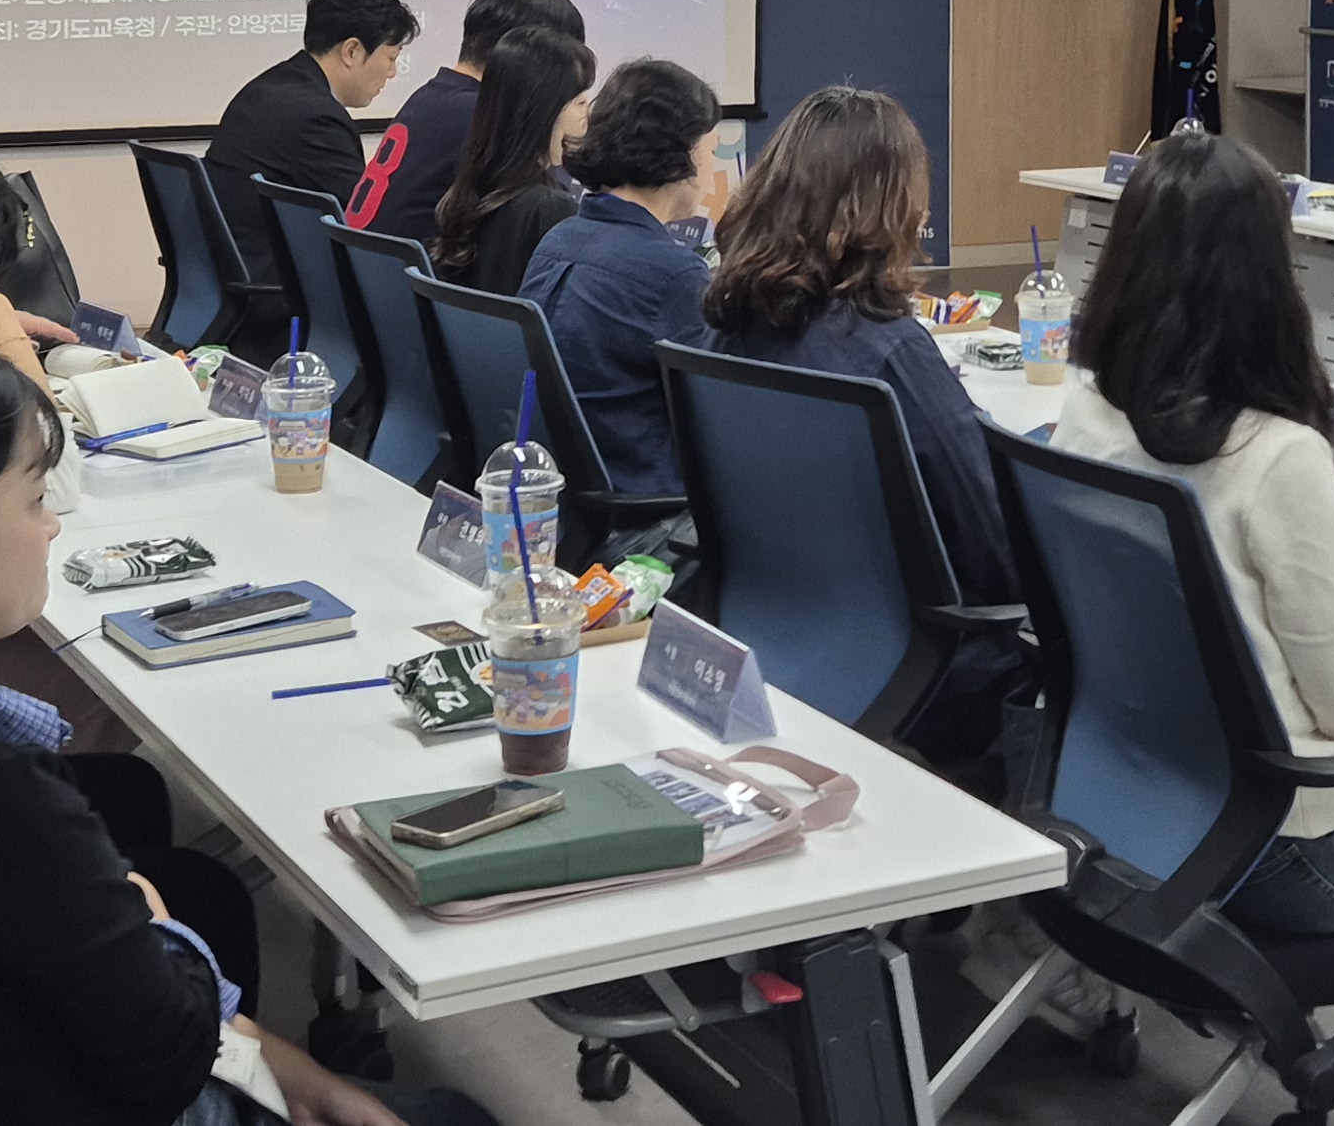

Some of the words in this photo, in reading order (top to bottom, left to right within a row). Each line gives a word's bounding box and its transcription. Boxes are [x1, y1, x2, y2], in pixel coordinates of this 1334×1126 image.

[25, 16, 155, 41] 경기도교육청
[161, 17, 171, 39] /
[174, 15, 223, 37] 주관:
